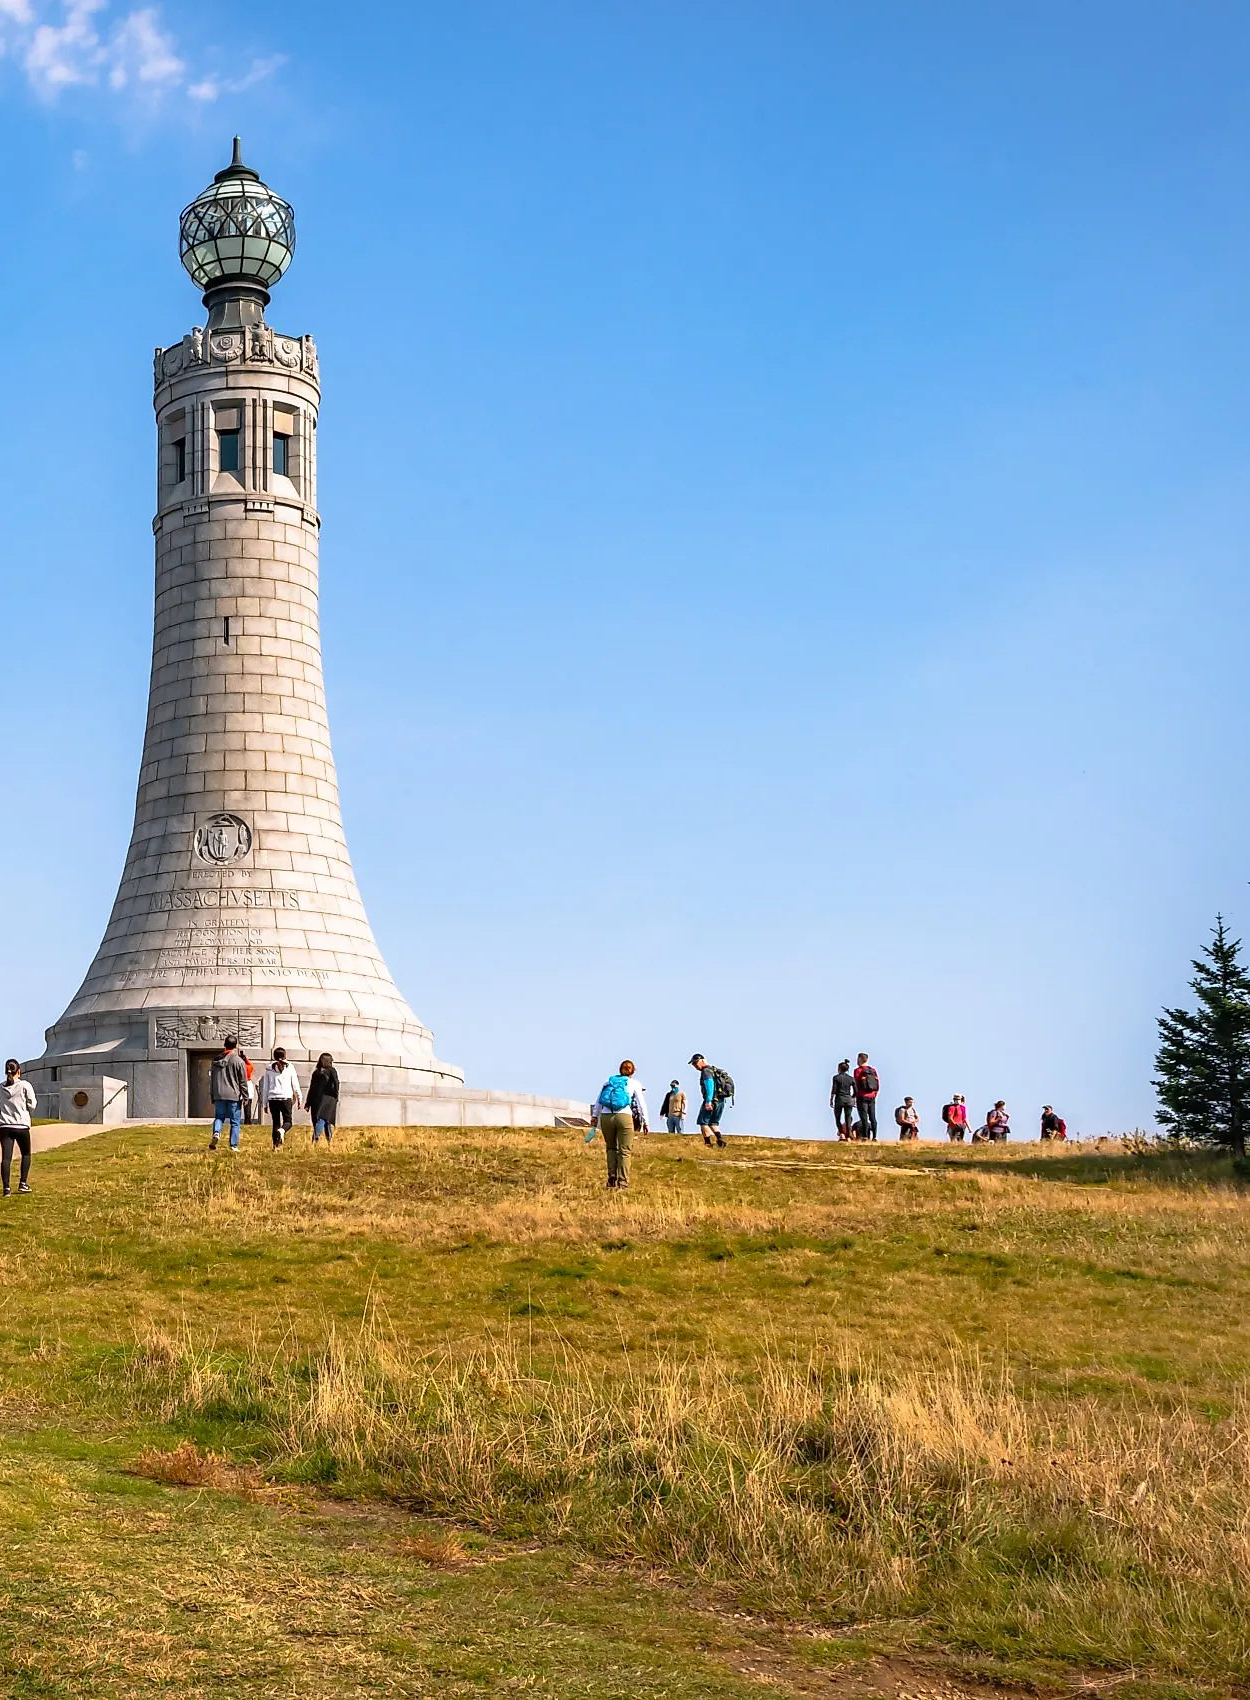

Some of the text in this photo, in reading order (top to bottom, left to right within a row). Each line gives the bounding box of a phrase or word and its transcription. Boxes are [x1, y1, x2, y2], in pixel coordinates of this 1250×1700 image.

[192, 870, 251, 880] ERECTED BY
[232, 947, 252, 955] HER
[256, 948, 280, 956] SONS
